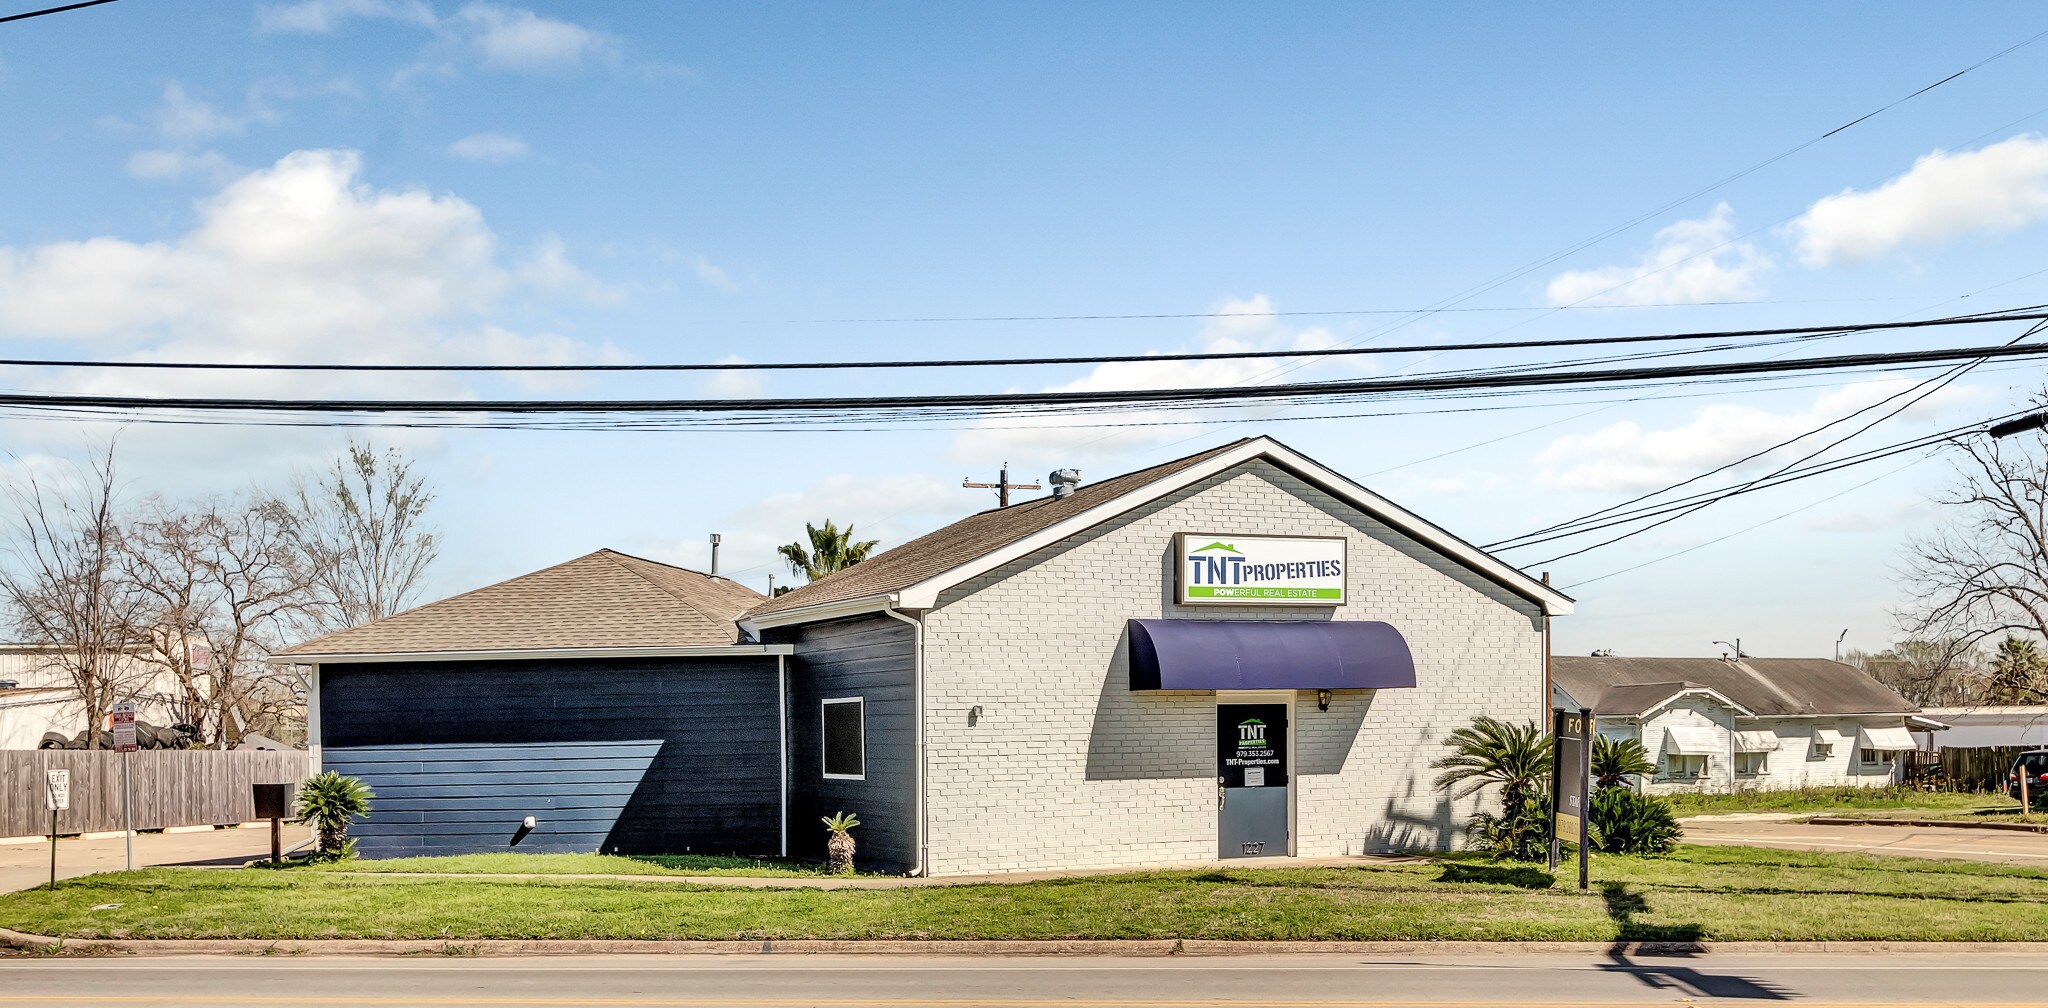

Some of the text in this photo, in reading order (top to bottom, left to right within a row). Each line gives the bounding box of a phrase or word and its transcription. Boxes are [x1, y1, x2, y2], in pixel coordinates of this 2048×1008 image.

[1188, 556, 1341, 584] TNT PROPERTIES
[1213, 588, 1317, 597] POWERFUL REAL ESTATE
[1238, 725, 1266, 739] TNT
[52, 774, 65, 782] EXIT
[50, 783, 67, 791] ONLY
[1242, 841, 1265, 855] 1227
